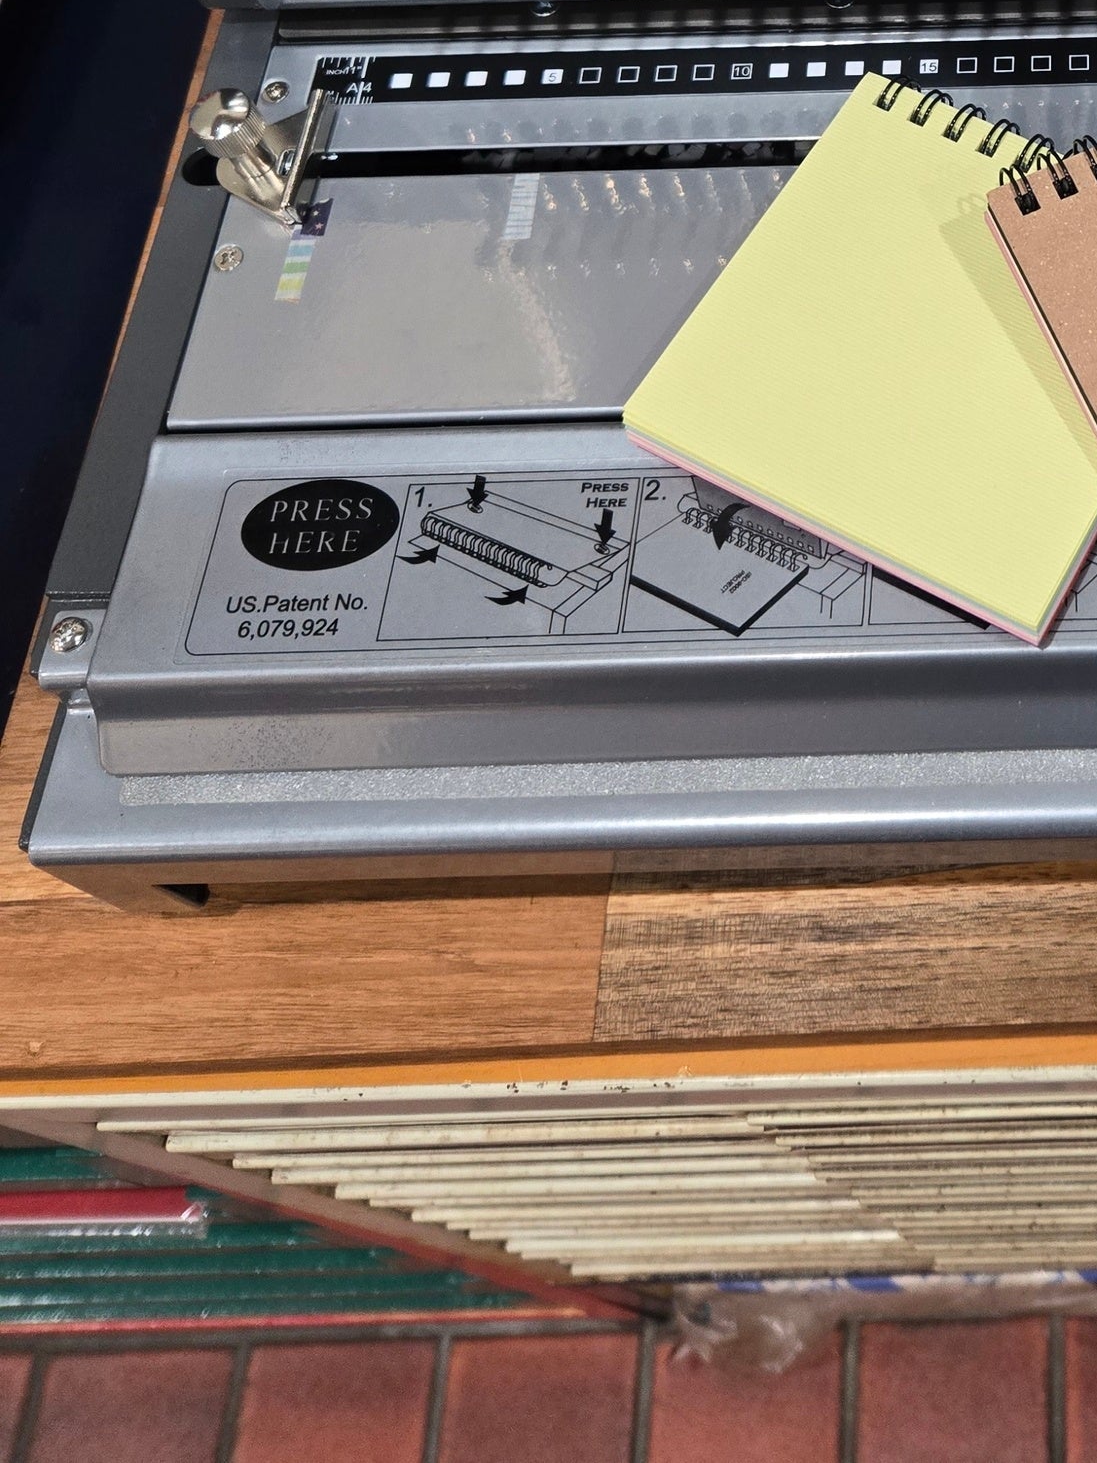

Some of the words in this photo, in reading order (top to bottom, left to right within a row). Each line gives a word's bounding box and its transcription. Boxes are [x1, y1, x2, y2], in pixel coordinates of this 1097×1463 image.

[547, 71, 557, 83] 5
[733, 66, 750, 78] 10
[921, 61, 938, 74] 15
[413, 488, 433, 508] 1.
[644, 479, 667, 502] 2.
[269, 497, 374, 523] PRESS
[268, 528, 361, 555] HERE
[226, 594, 331, 615] US.Patent
[334, 593, 369, 612] No.
[237, 617, 339, 640] 6,079,924
